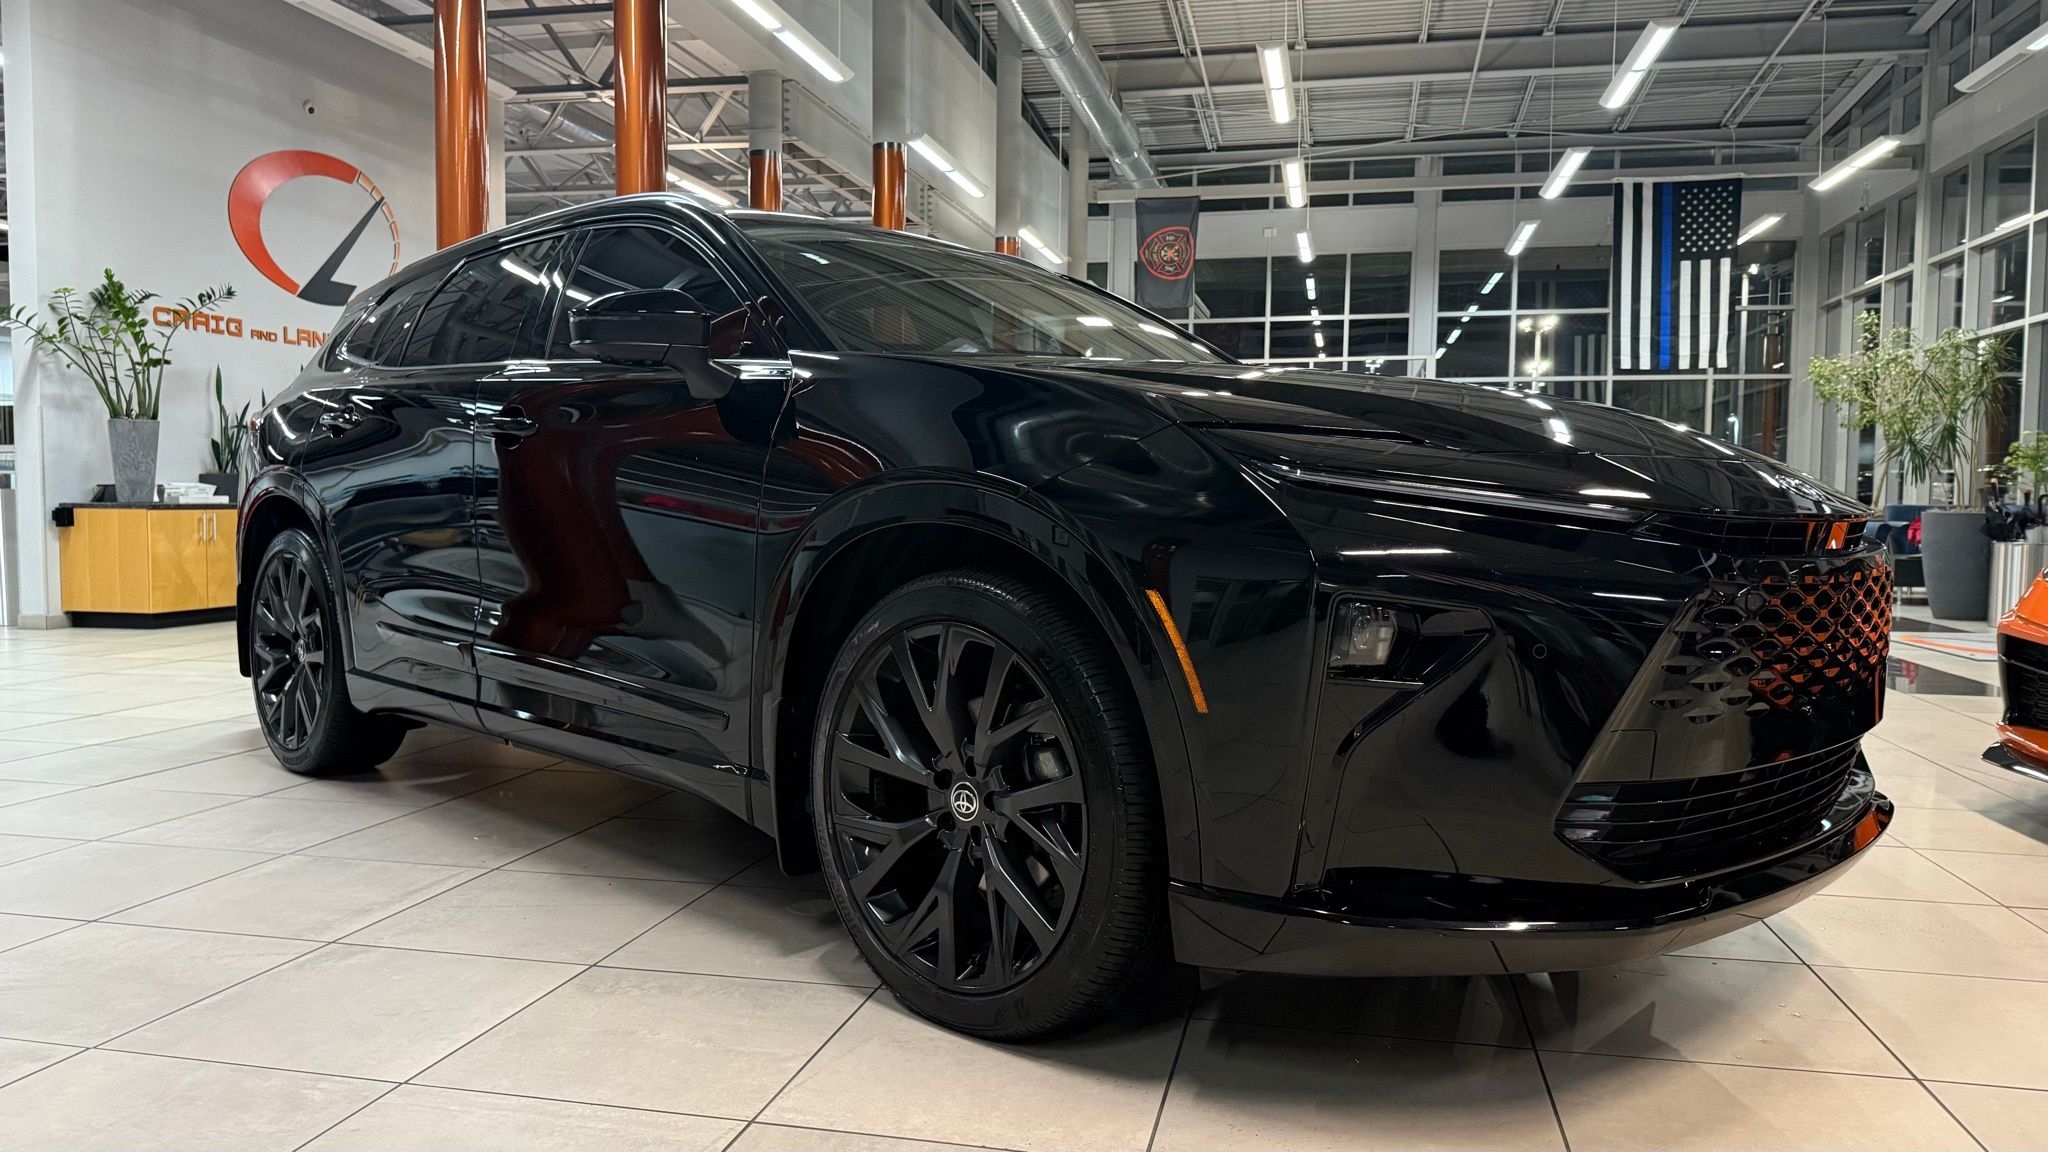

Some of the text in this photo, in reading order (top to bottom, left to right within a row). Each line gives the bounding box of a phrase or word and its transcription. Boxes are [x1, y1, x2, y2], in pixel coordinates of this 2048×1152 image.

[152, 305, 329, 348] CRAIG AND LAN
